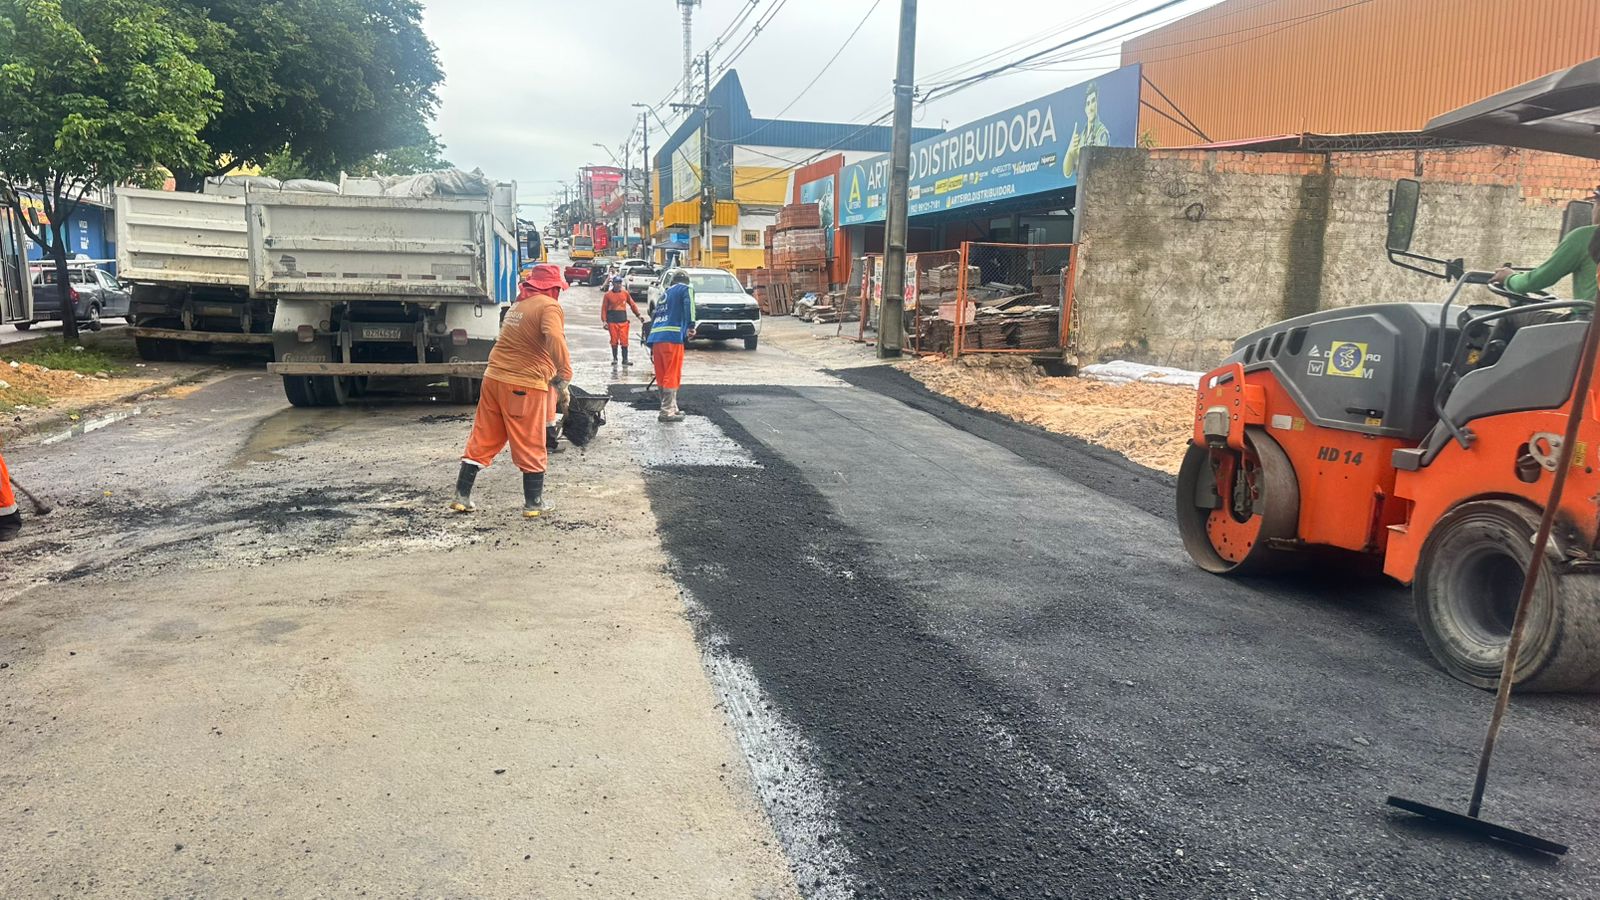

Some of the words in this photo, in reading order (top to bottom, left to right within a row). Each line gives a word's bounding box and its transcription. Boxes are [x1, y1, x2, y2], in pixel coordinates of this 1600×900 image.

[919, 104, 1057, 179] DISTRIBUIDORA
[1317, 446, 1340, 462] HD
[1344, 450, 1364, 466] 14
